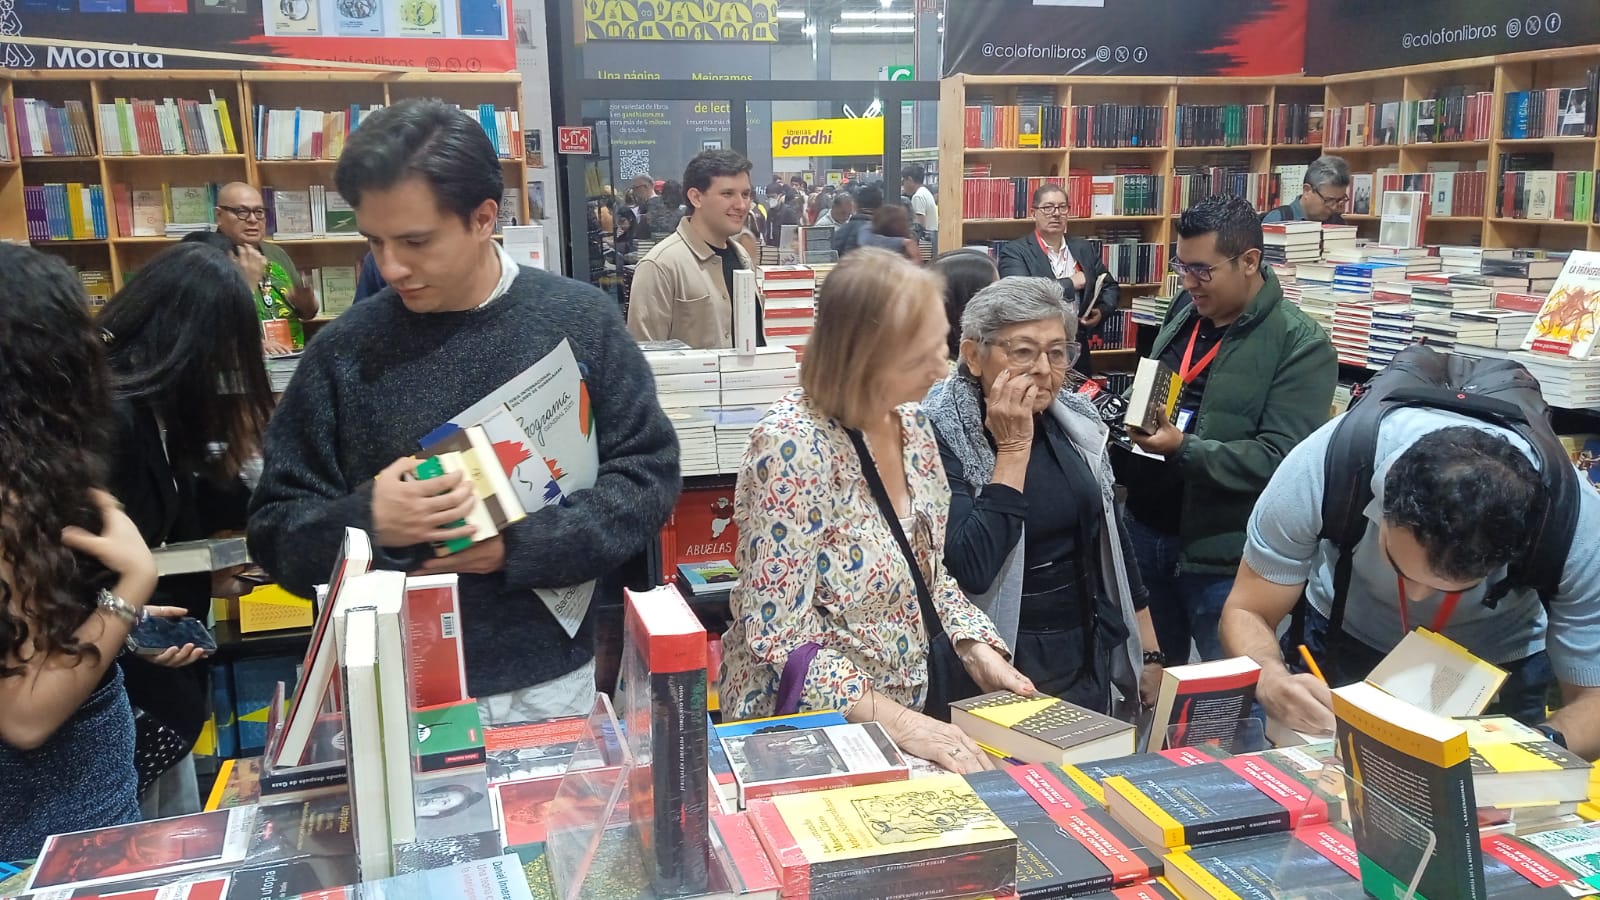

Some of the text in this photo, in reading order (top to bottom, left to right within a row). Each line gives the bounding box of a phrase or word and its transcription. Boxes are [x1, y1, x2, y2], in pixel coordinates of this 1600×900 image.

[1402, 24, 1496, 48] @colofonlibros
[982, 43, 1086, 60] @colofonlibros
[694, 102, 708, 112] de
[782, 130, 832, 149] gandhi
[686, 542, 732, 556] ABUELAS
[299, 776, 324, 784] después
[1024, 774, 1058, 805] PREMIO NOBEL
[1038, 778, 1066, 803] LITERATURA
[1244, 767, 1289, 798] PREMIO NOBEL
[1261, 771, 1298, 796] LITERATURA
[1062, 801, 1072, 810] DE
[1068, 822, 1111, 857] PREMIO NOBEL
[1084, 826, 1120, 855] LITERATURA
[1318, 839, 1344, 856] NOBEL
[1116, 853, 1129, 863] DE
[1494, 846, 1553, 882] PREMIO NOBEL
[1514, 850, 1559, 880] LITERATURA
[492, 860, 505, 879] Daniel
